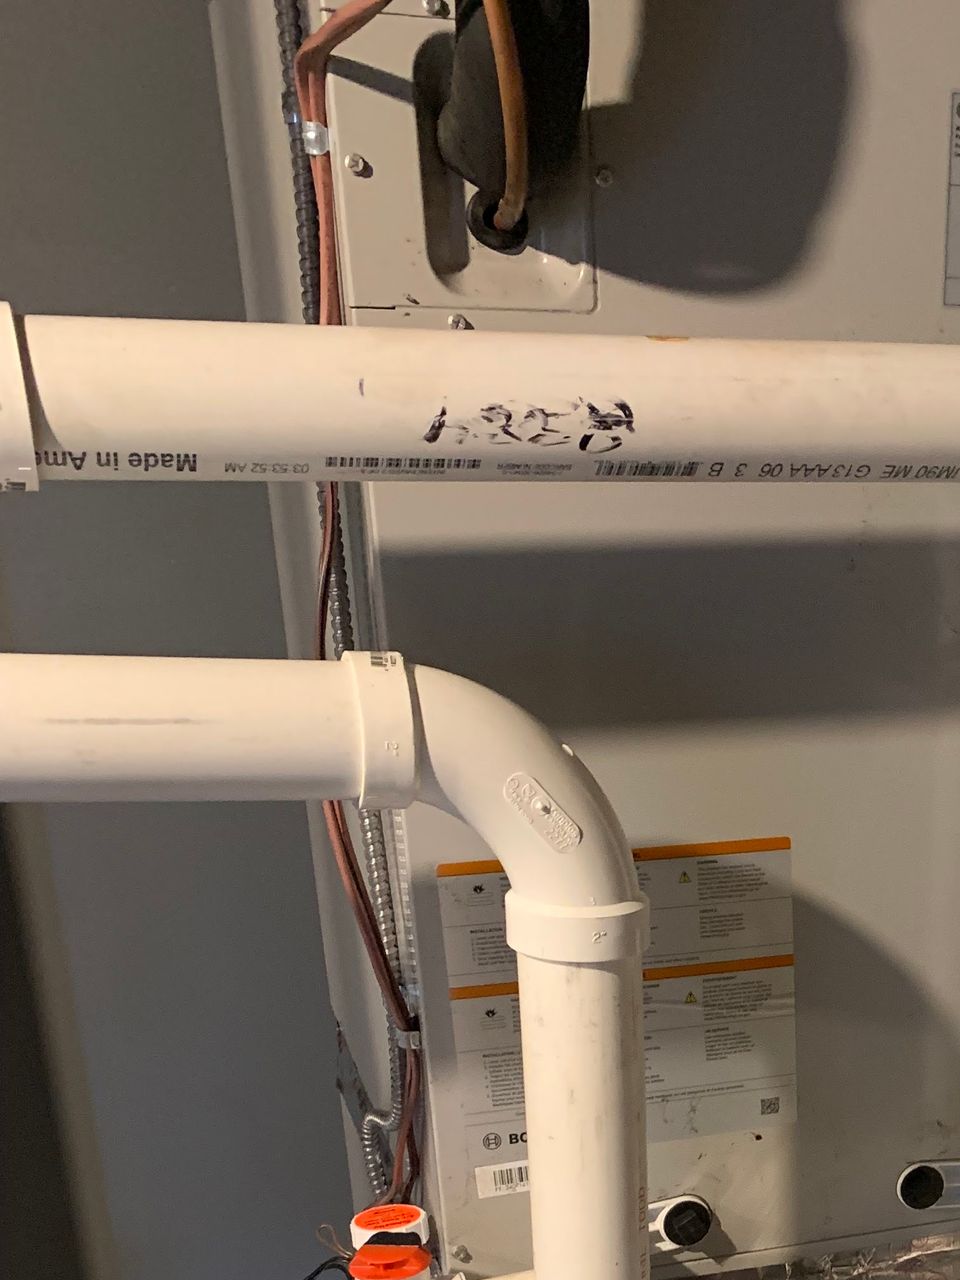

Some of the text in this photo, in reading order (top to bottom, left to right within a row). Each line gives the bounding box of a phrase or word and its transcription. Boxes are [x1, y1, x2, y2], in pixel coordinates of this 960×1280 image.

[96, 451, 119, 471] in
[128, 452, 198, 472] Made
[224, 462, 246, 473] AM
[708, 462, 725, 477] B
[735, 462, 748, 477] 3
[880, 464, 913, 479] ME
